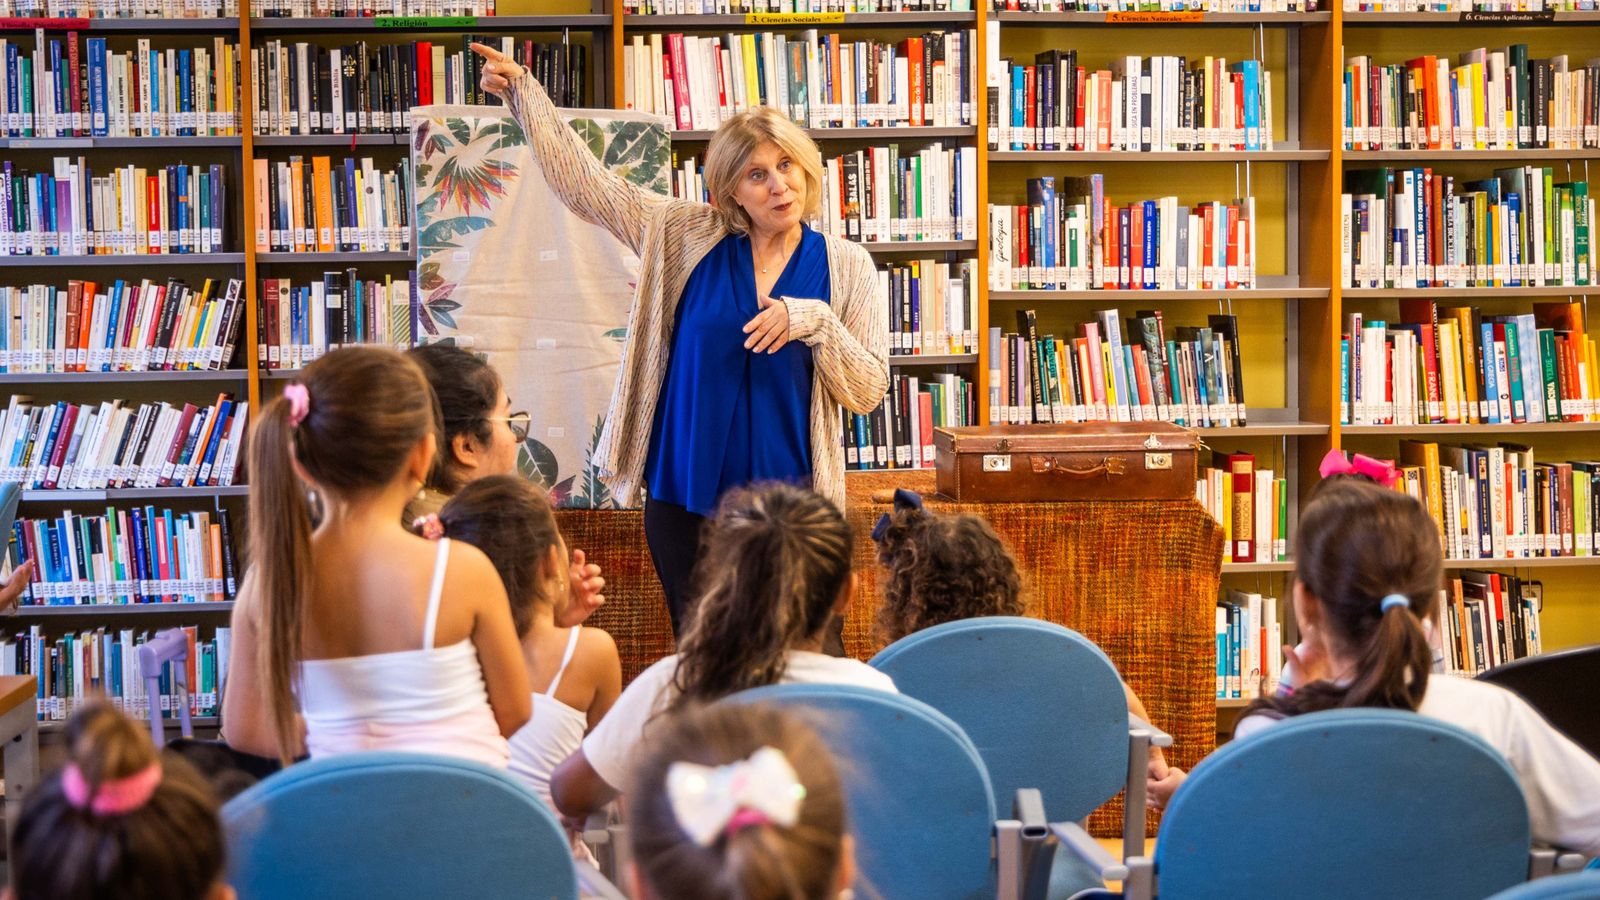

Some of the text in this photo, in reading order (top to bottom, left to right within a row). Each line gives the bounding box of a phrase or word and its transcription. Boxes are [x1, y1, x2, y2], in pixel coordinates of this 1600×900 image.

[382, 19, 428, 27] 2. Religión
[751, 15, 759, 23] 3.
[1503, 14, 1533, 22] Aplicadas
[334, 89, 340, 98] La
[5, 168, 13, 201] CANSADAS
[848, 173, 858, 203] SALAS
[1428, 371, 1438, 402] FRANC
[1548, 381, 1556, 399] CINA
[1494, 487, 1503, 523] BRICOLAJE
